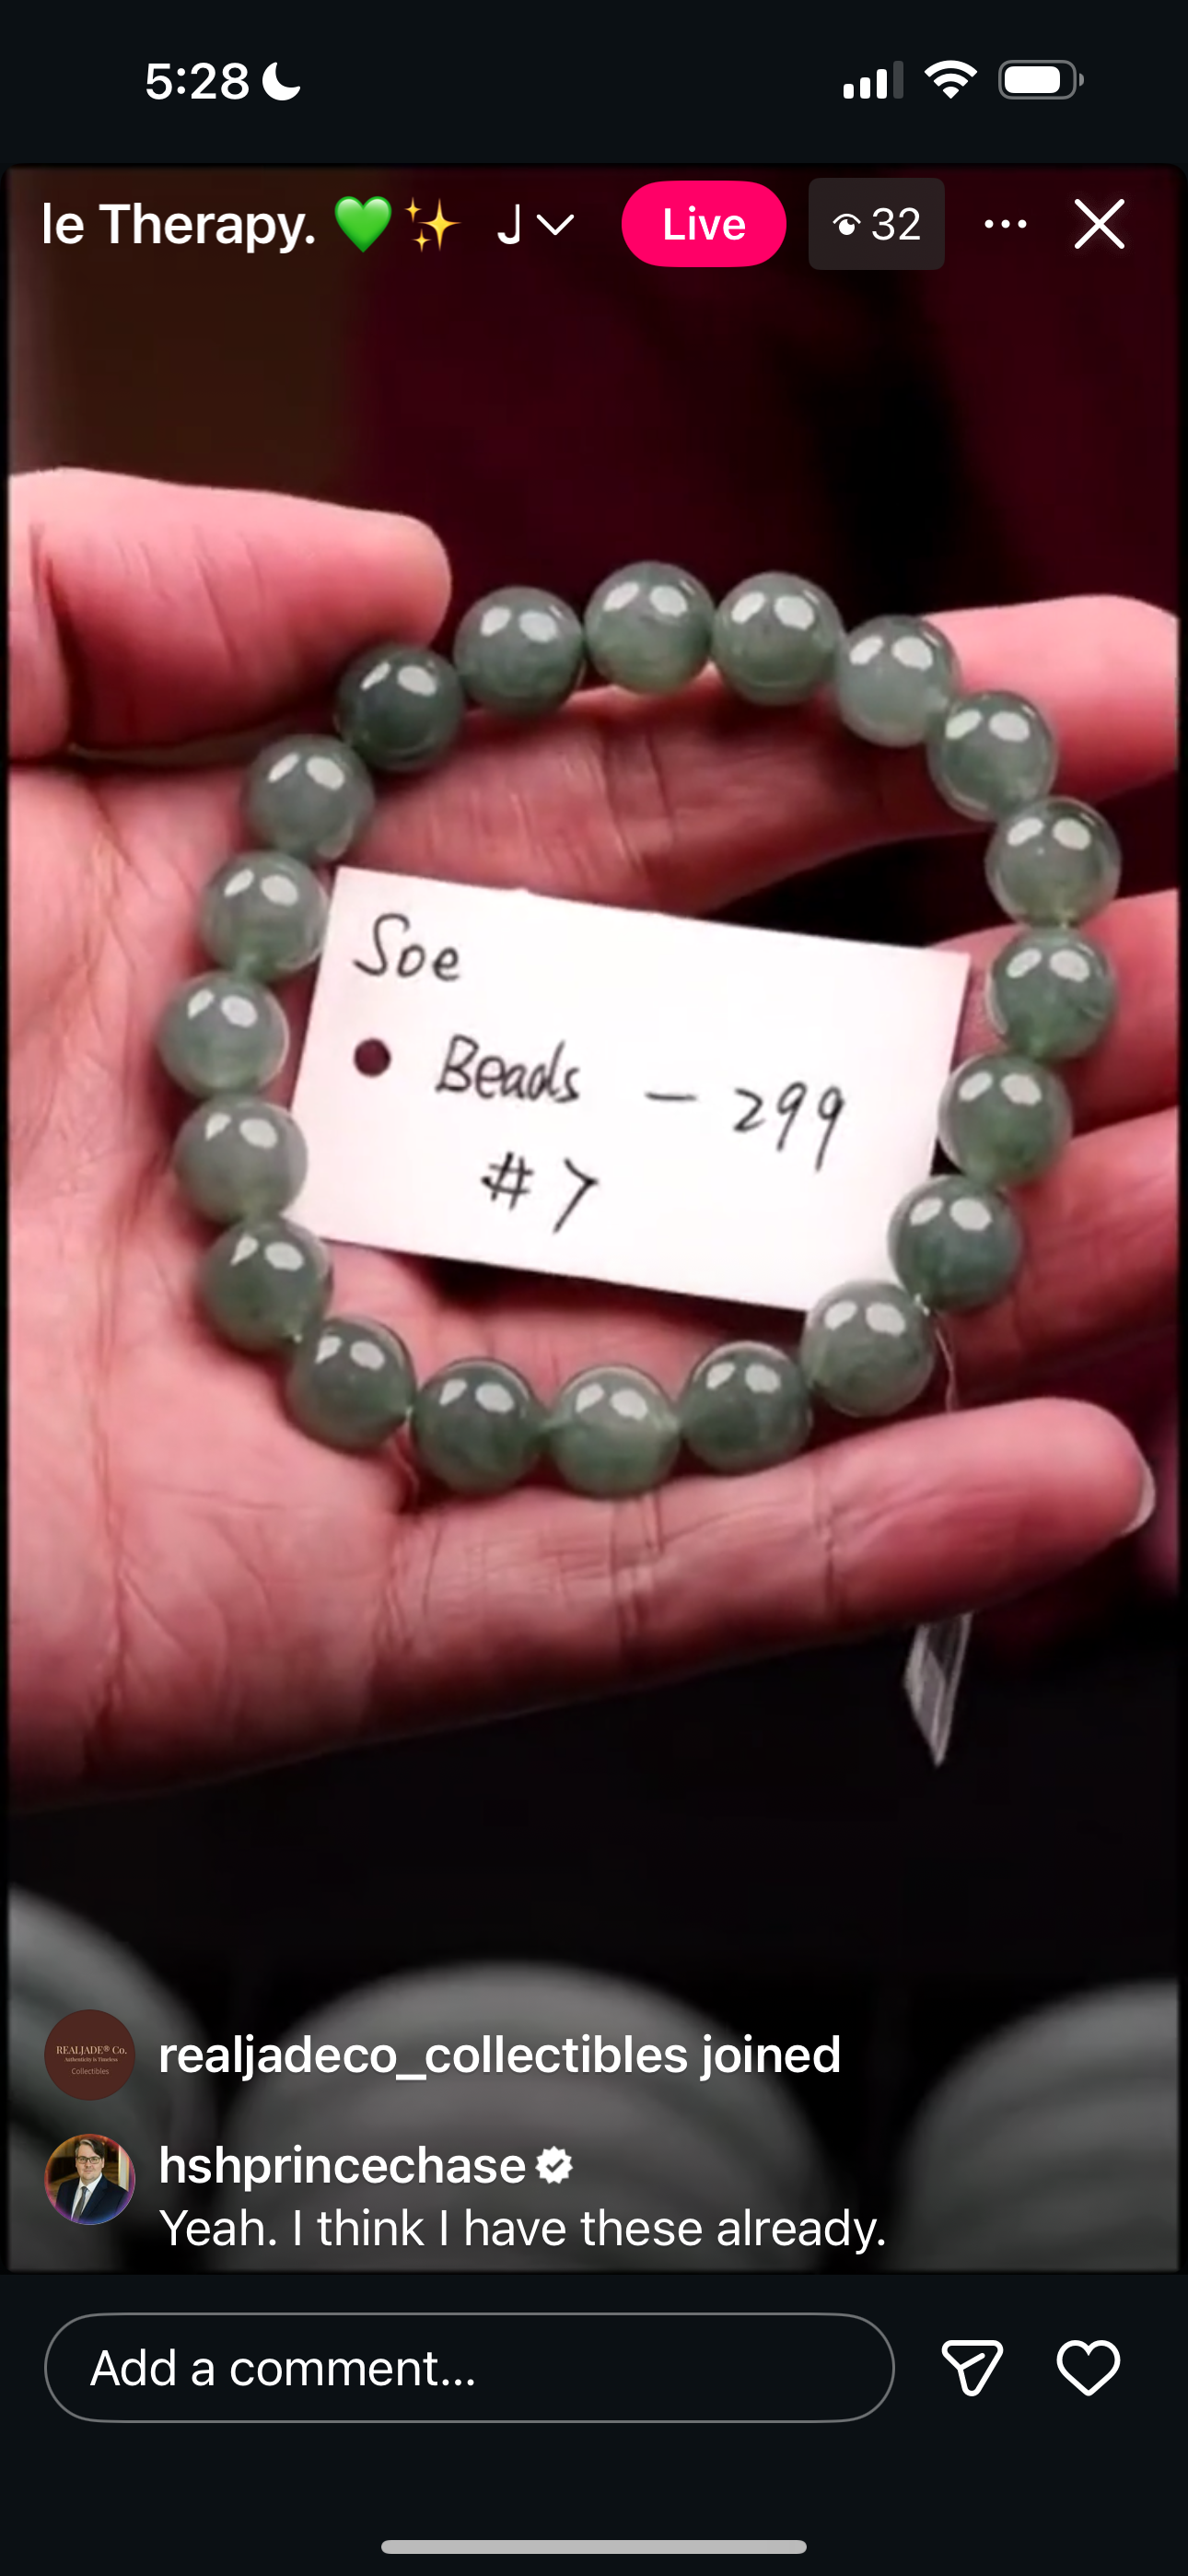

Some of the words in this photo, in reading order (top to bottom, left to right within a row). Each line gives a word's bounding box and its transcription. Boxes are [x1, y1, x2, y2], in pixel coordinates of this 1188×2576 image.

[354, 913, 461, 983] Soe
[435, 1033, 582, 1105] Beads
[731, 1080, 846, 1173] 299
